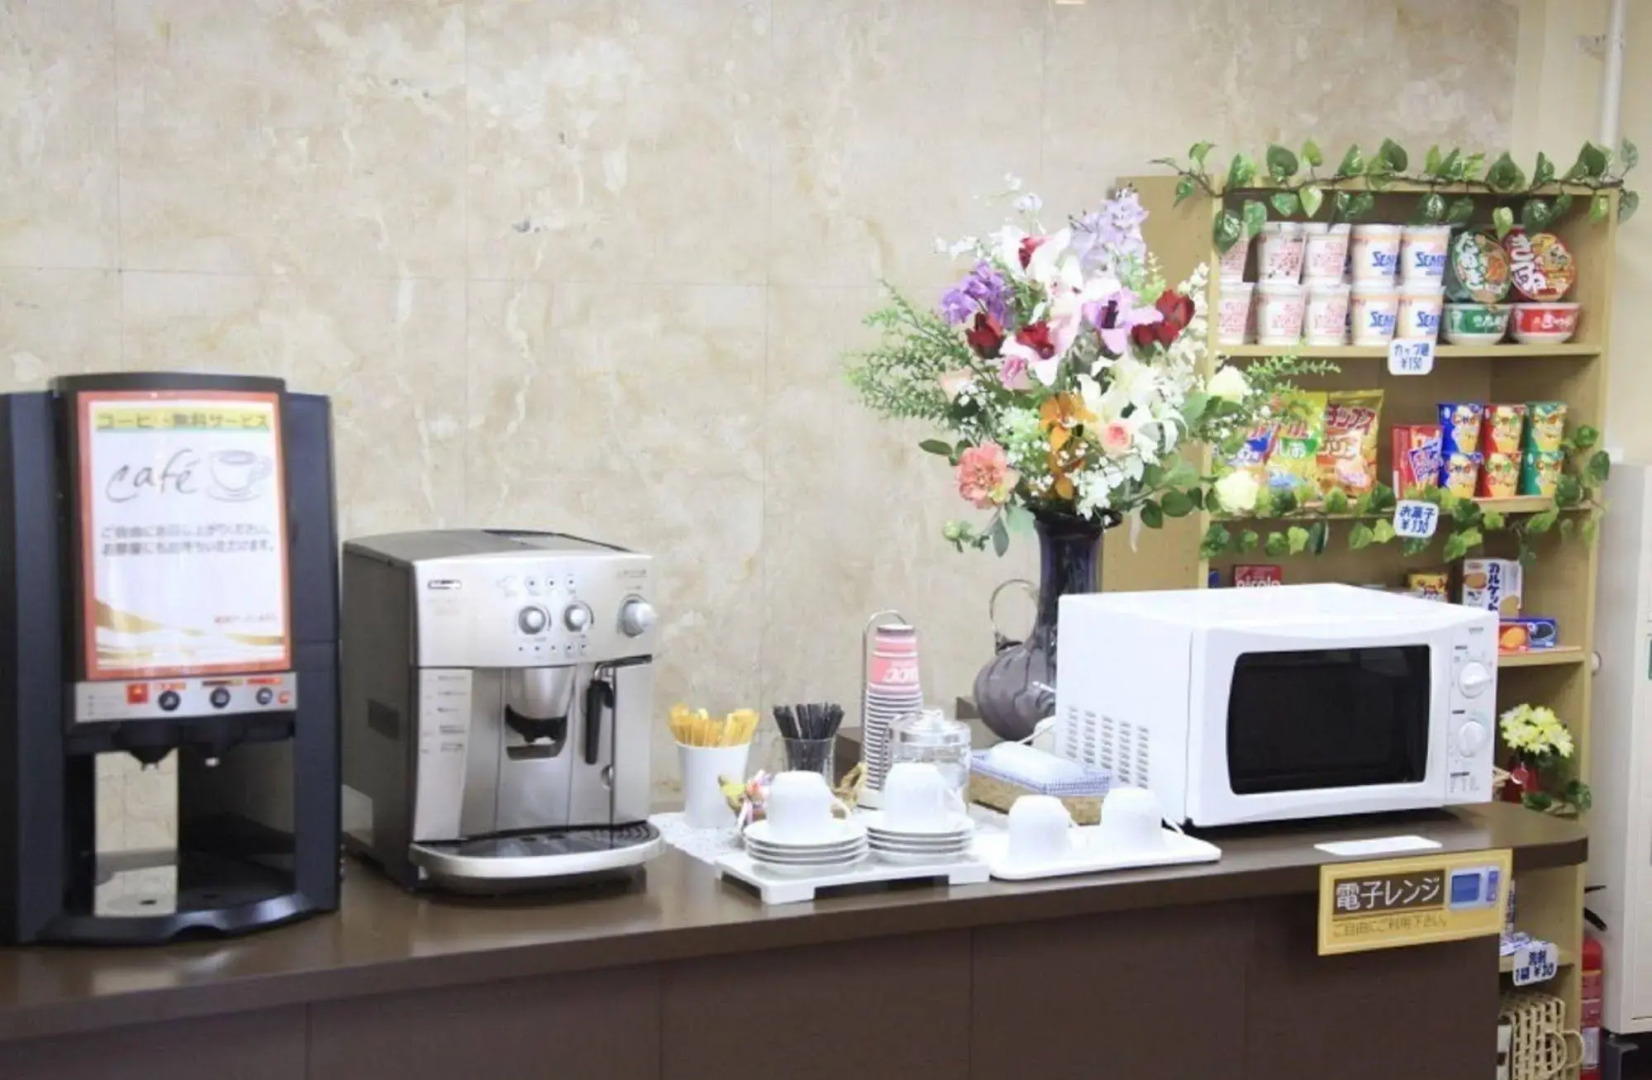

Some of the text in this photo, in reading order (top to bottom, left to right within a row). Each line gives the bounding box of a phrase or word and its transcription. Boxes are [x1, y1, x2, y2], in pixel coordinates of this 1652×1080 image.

[1336, 877, 1440, 911] 電子レンジ
